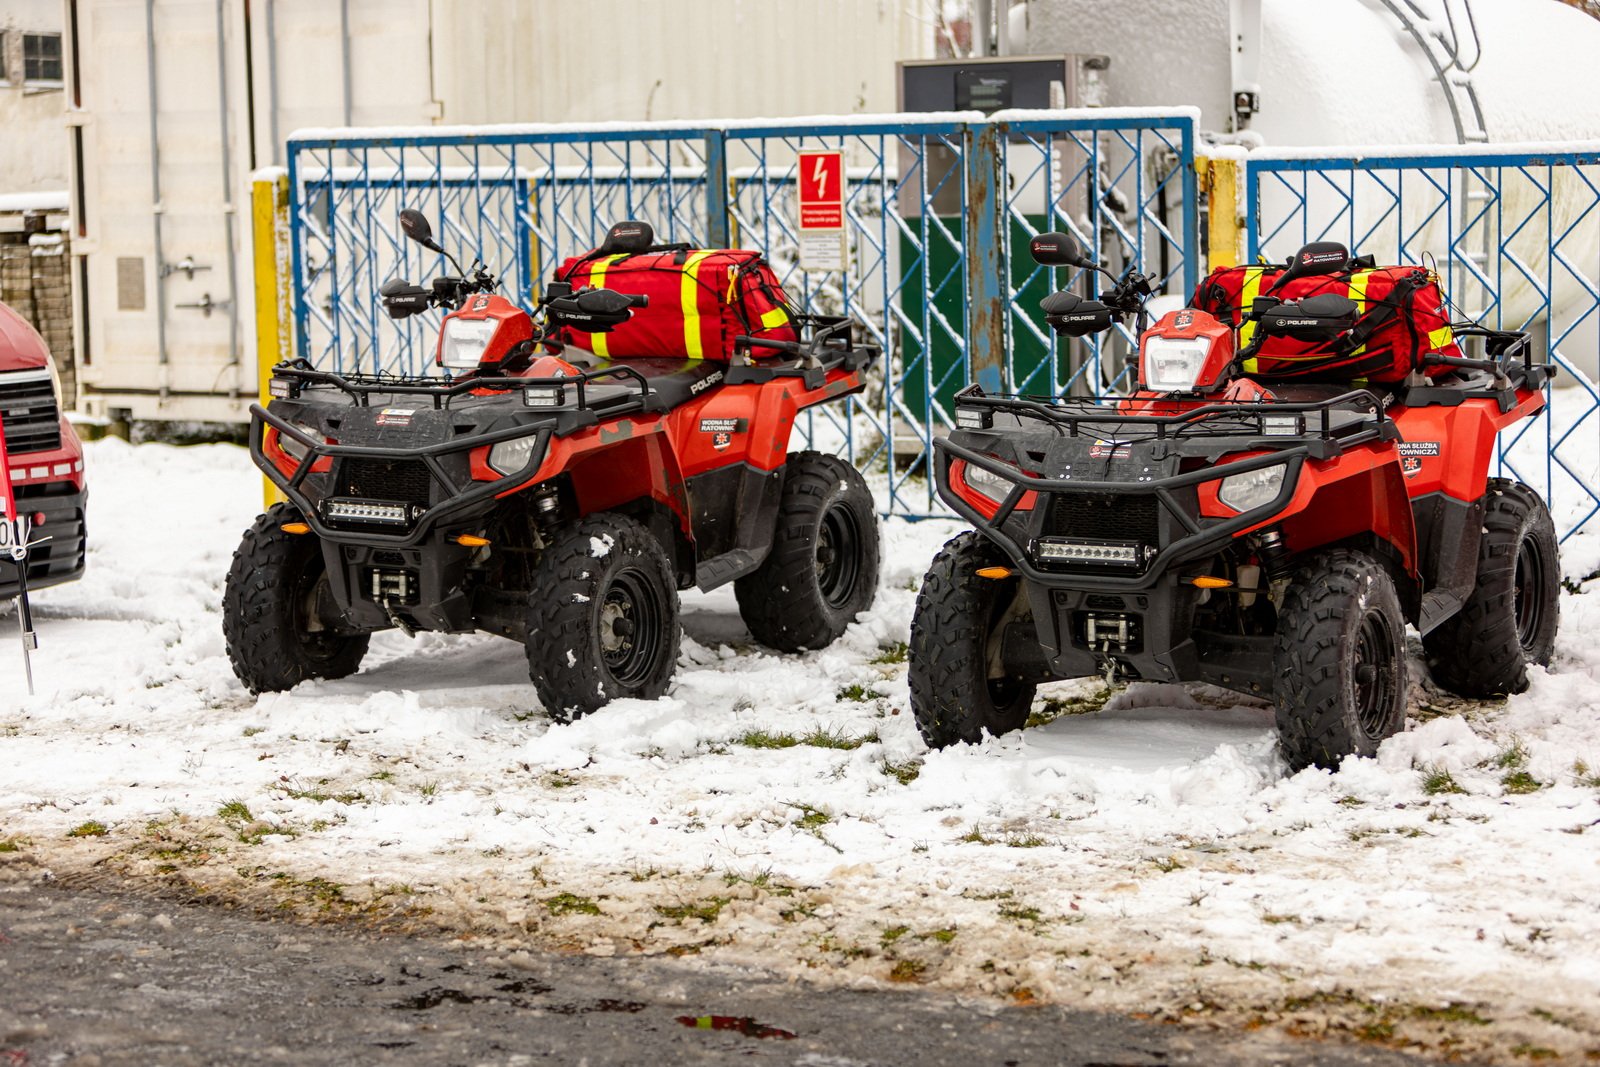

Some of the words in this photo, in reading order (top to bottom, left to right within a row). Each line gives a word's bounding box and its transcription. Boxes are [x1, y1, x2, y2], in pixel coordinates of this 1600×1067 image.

[565, 313, 593, 321] POLARIS
[690, 370, 724, 395] POLARIS
[1411, 442, 1438, 450] SŁUŻBA
